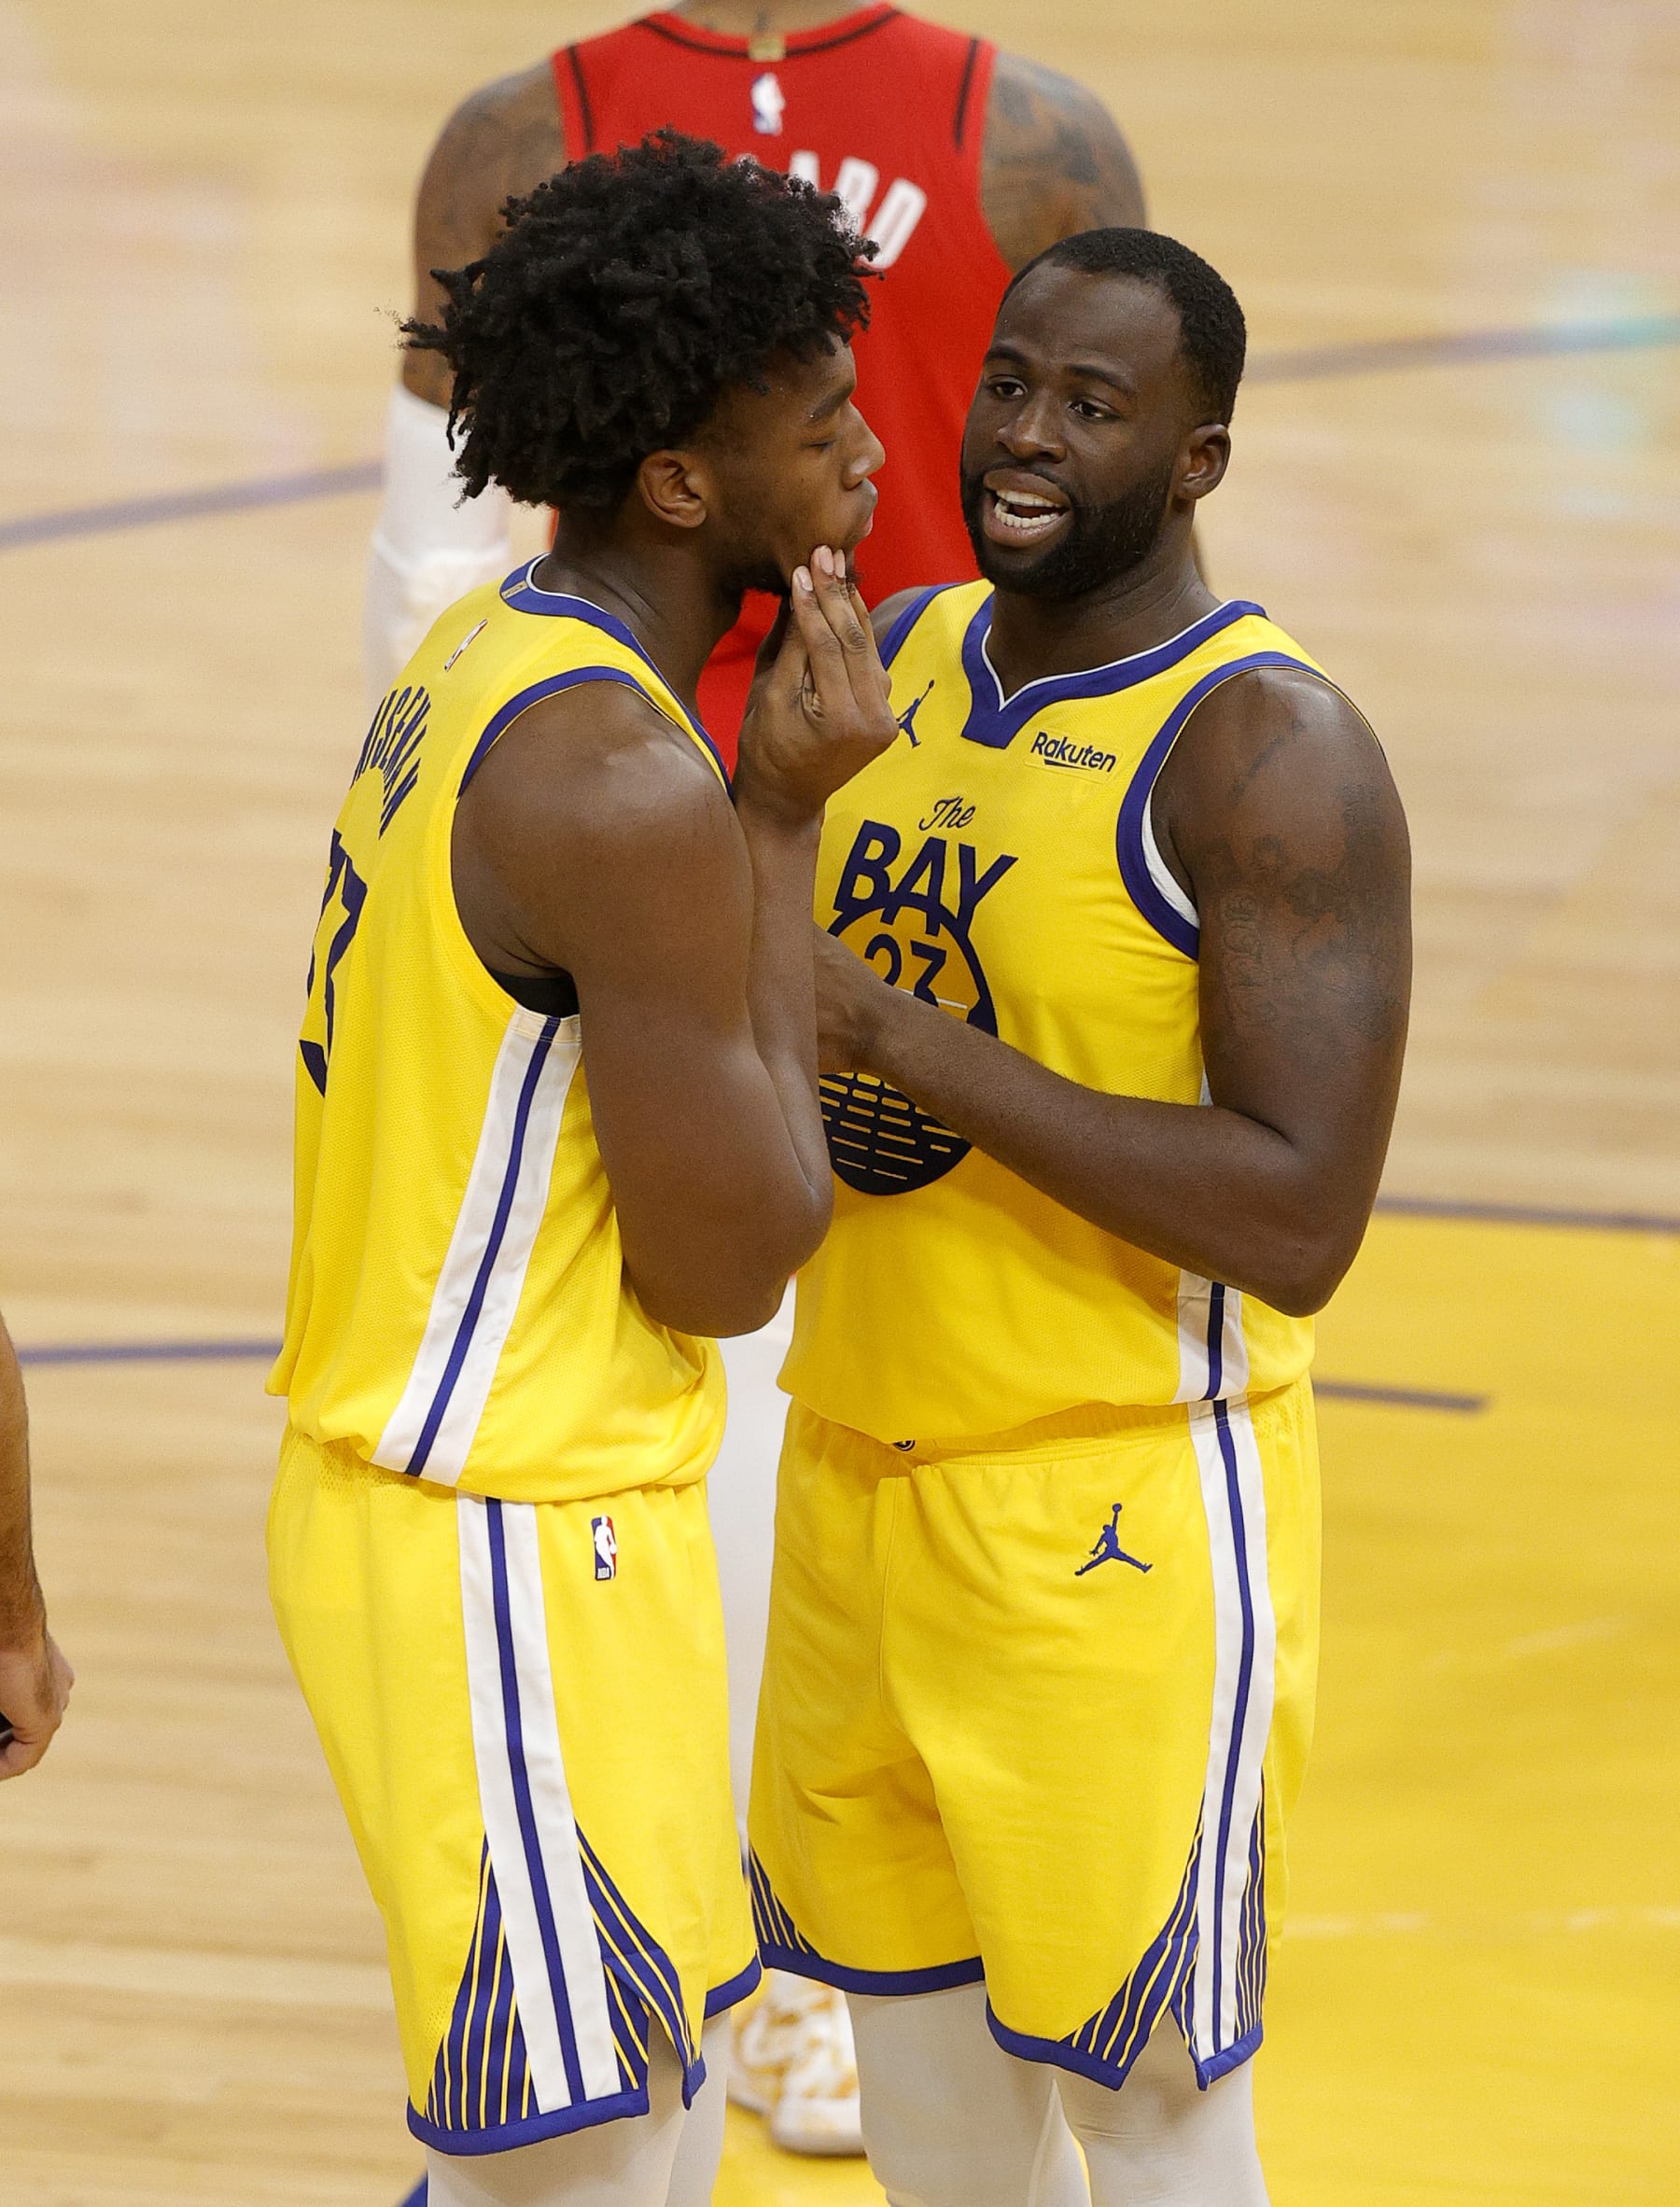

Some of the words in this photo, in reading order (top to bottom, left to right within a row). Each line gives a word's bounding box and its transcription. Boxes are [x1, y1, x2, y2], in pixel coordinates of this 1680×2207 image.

[1030, 731, 1116, 773] Rakuten
[918, 796, 976, 831] The
[833, 819, 1019, 937] BAY
